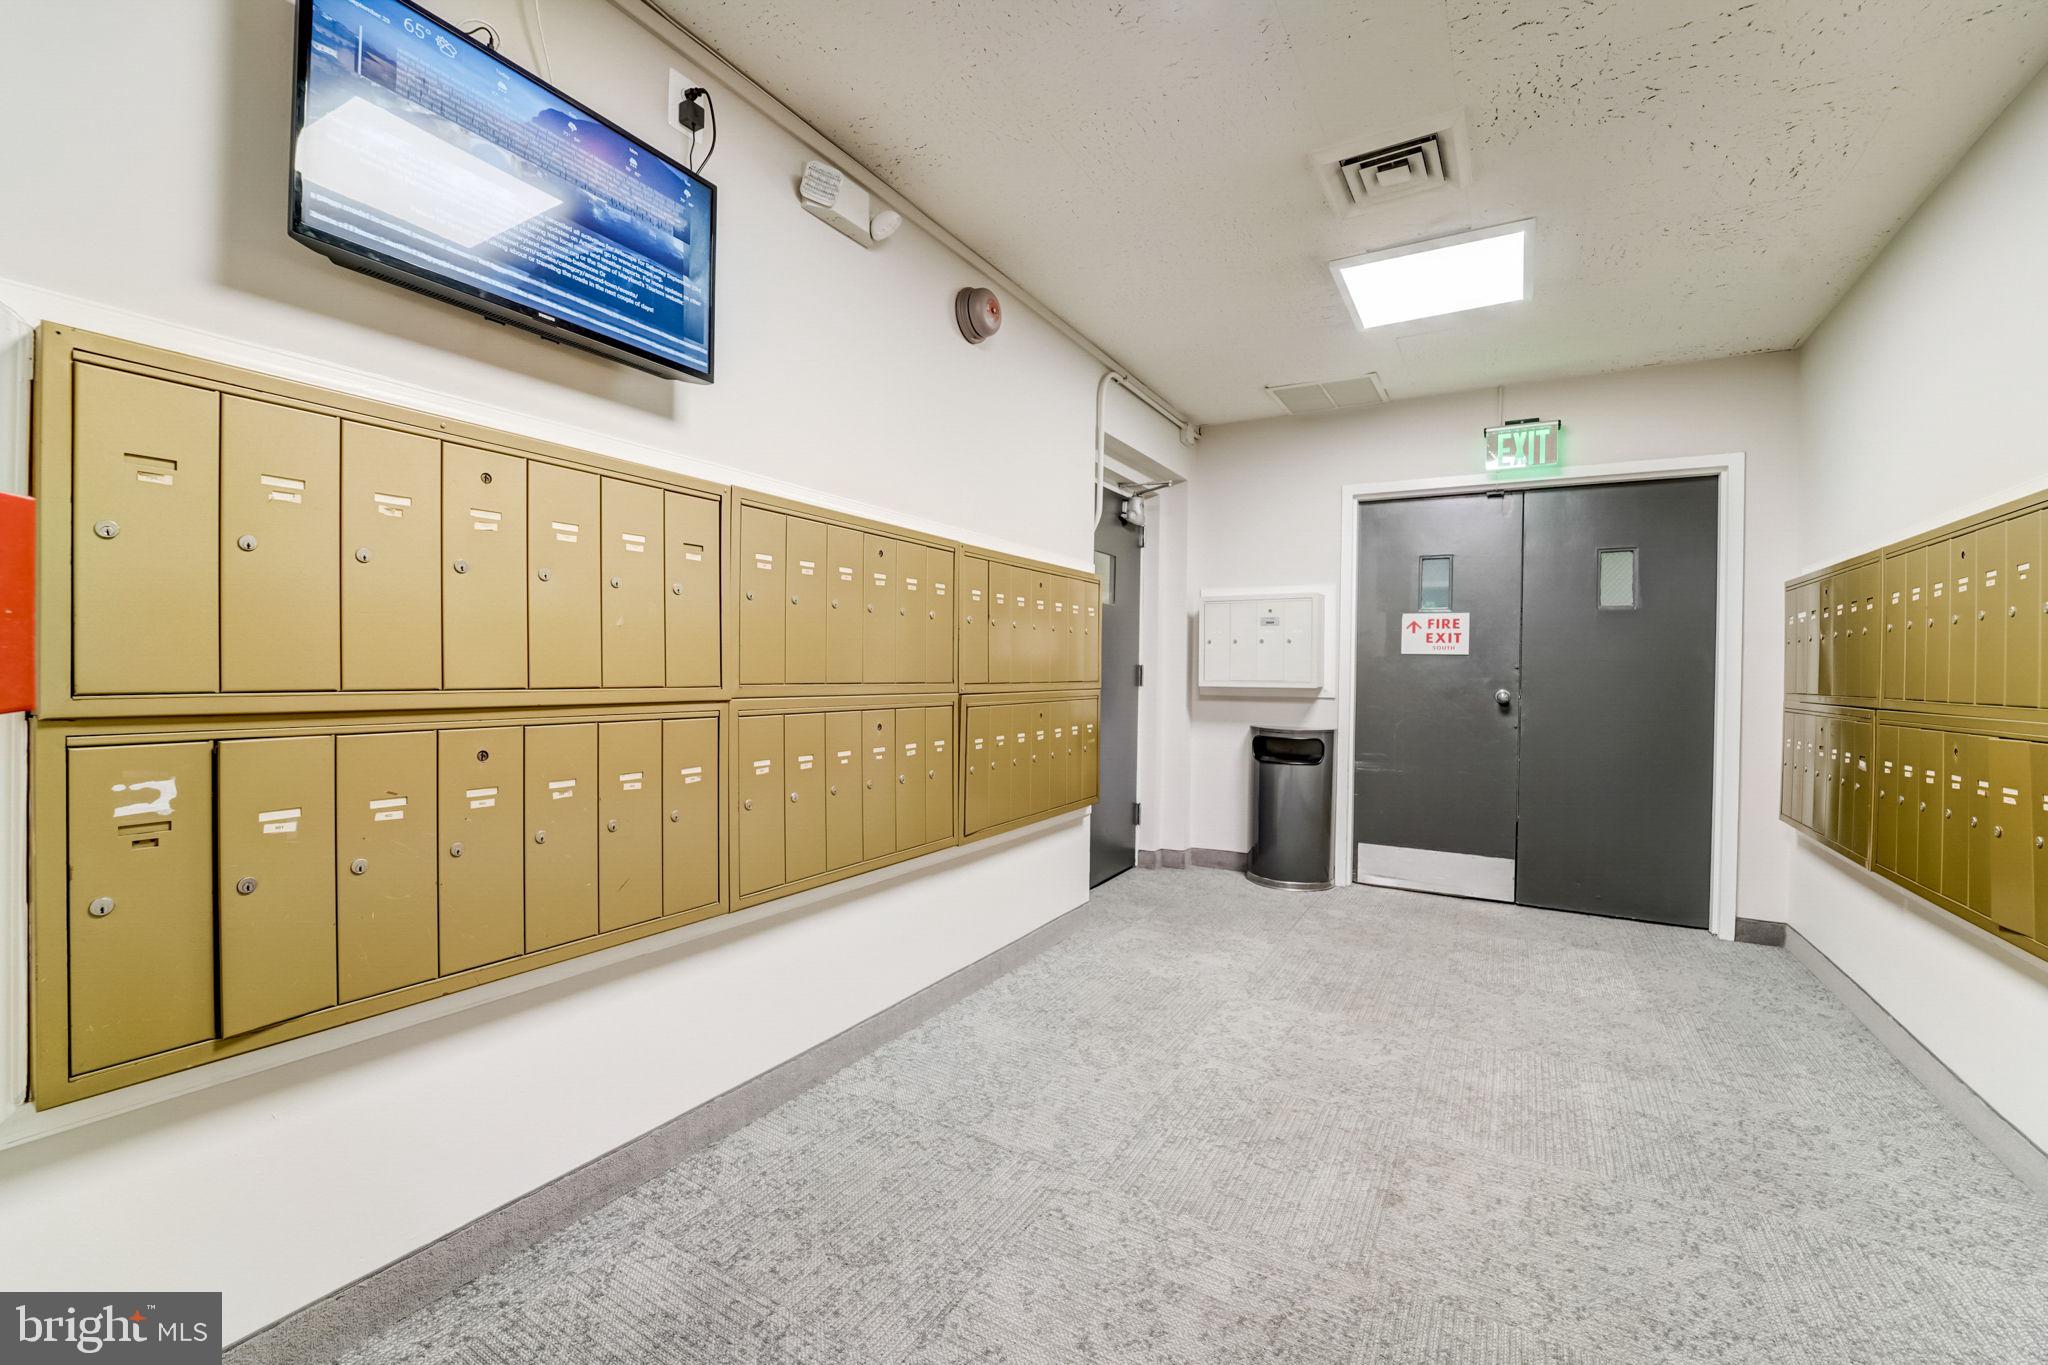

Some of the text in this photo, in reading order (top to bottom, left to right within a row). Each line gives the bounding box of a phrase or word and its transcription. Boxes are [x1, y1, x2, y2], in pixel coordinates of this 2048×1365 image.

[403, 17, 432, 40] 65°
[1497, 429, 1551, 467] EXIT
[1427, 618, 1460, 629] FIRE
[1425, 632, 1462, 643] EXIT
